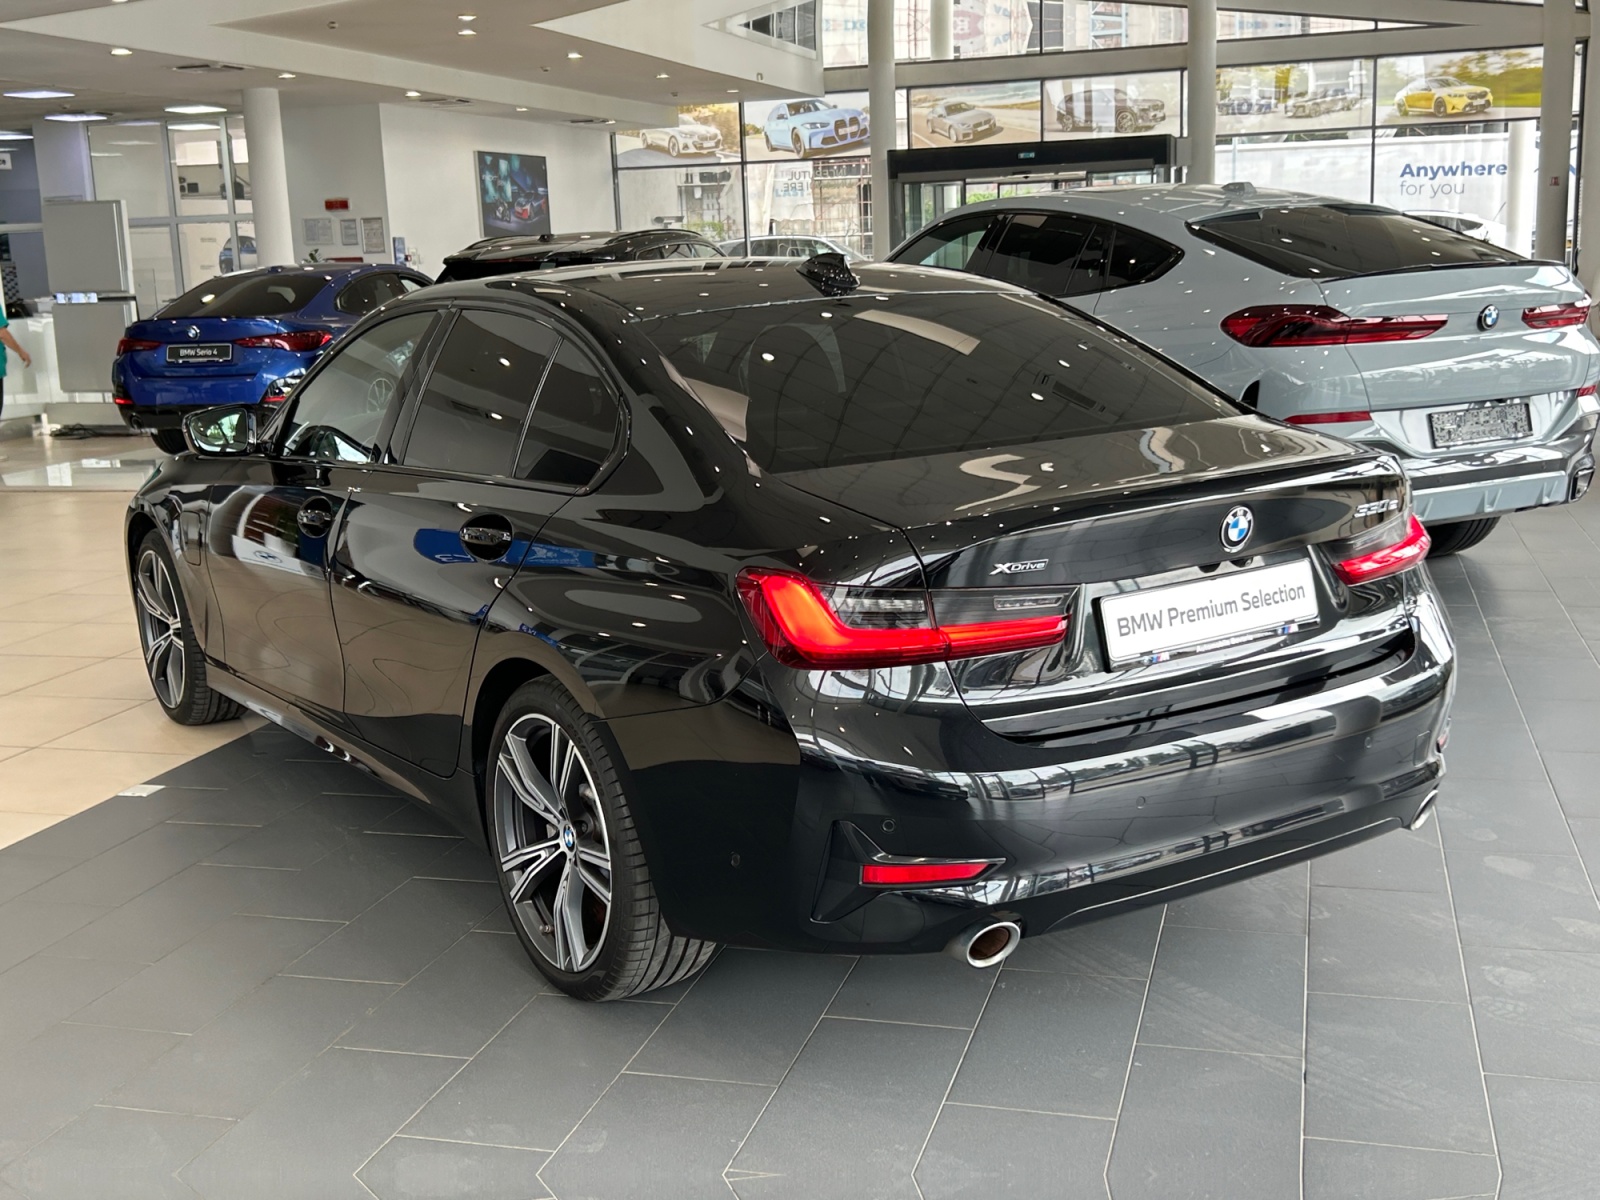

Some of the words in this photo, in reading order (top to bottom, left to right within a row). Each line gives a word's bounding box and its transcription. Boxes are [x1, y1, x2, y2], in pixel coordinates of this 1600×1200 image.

[1400, 161, 1508, 181] Anywhere
[1400, 180, 1425, 196] for
[1429, 183, 1465, 199] you
[179, 348, 195, 357] BMW
[213, 348, 218, 356] 4
[1117, 609, 1164, 637] BMW
[1167, 598, 1239, 627] Premium
[1240, 584, 1306, 612] Selection
